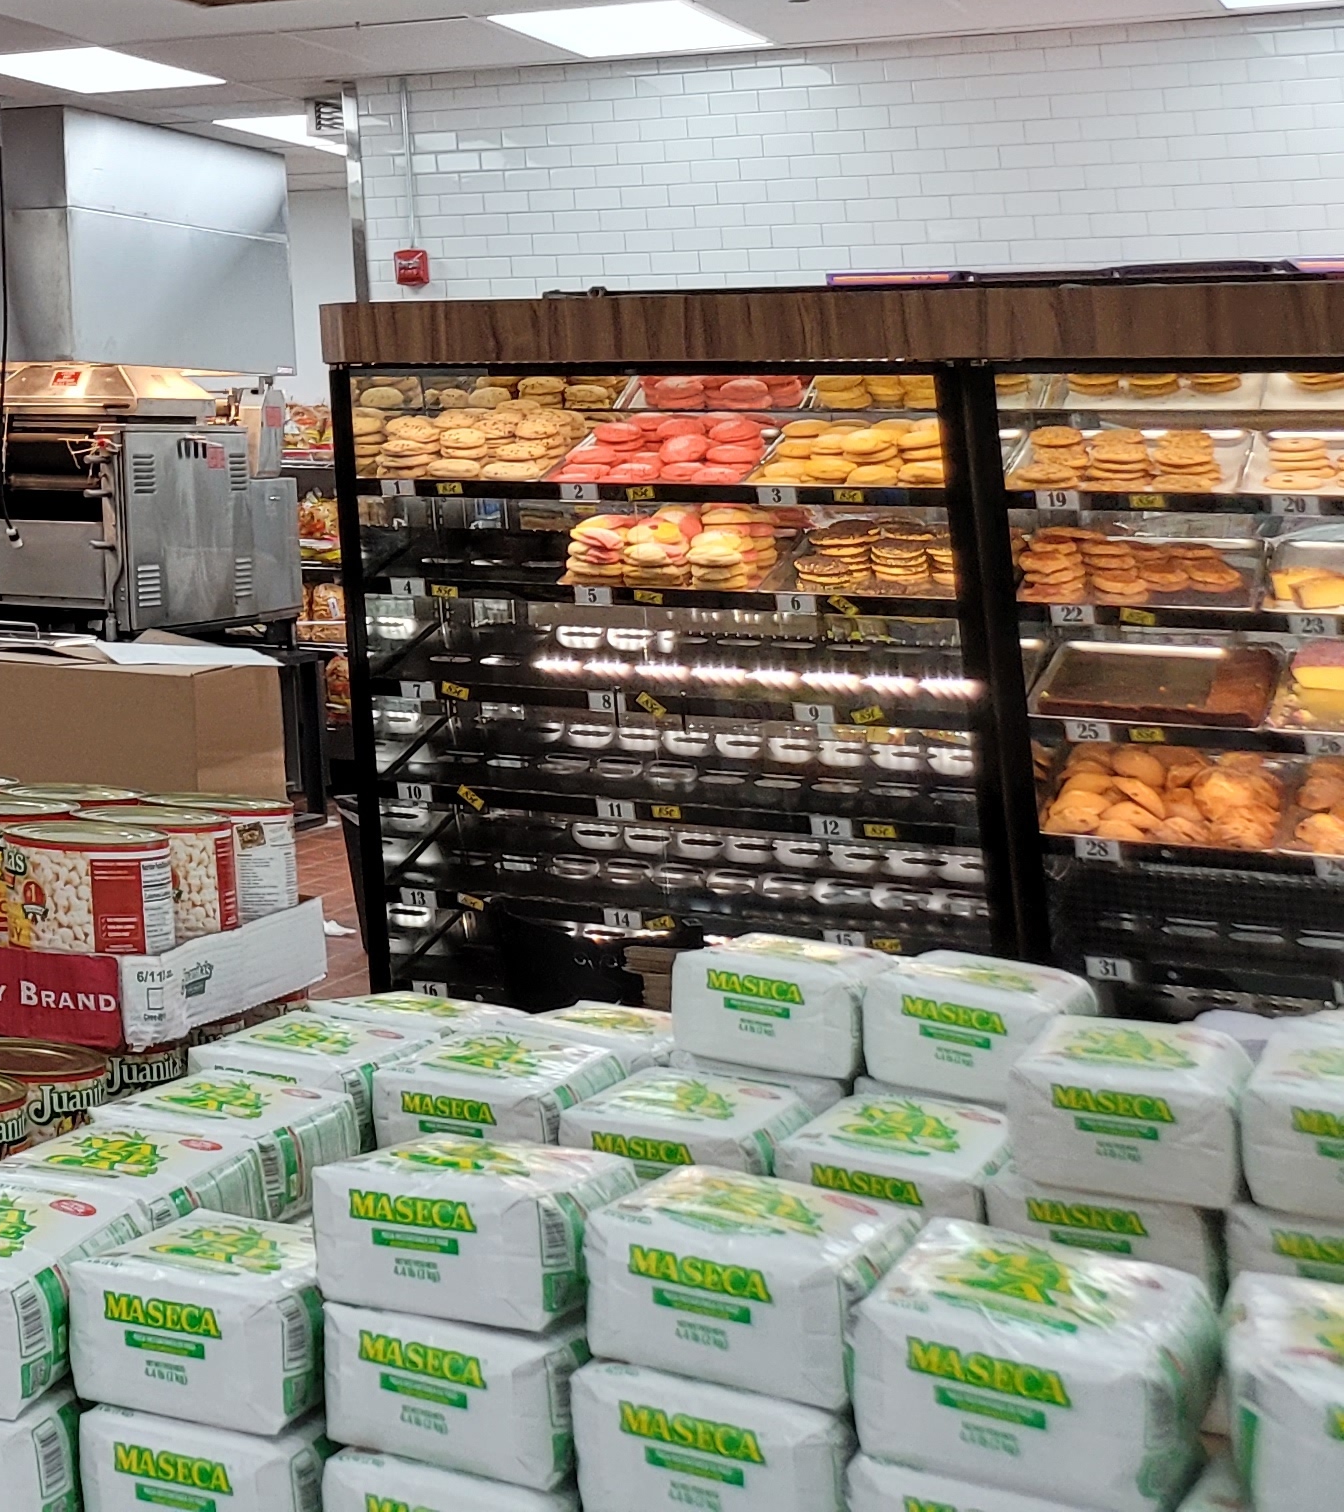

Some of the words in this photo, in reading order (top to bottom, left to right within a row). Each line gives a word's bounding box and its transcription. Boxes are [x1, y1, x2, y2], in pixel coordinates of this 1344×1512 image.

[393, 482, 401, 495] 1
[574, 484, 583, 499] 2
[772, 489, 782, 503] 3
[1047, 492, 1067, 508] 19
[402, 579, 411, 594] 4
[587, 588, 597, 603] 5
[791, 597, 801, 612] 6
[413, 684, 421, 697] 7
[602, 694, 612, 709] 8
[809, 707, 819, 721] 9
[1077, 724, 1098, 739] 25
[408, 786, 422, 799] 10
[609, 804, 622, 817] 11
[822, 820, 839, 835] 12
[1087, 842, 1108, 857] 28
[411, 891, 425, 905] 13
[613, 912, 629, 926] 14
[1100, 962, 1118, 976] 31
[708, 969, 804, 1005] MASECA
[21, 980, 116, 1012] BRAND
[902, 995, 1007, 1036] MASECA
[107, 1056, 184, 1093] Juanita
[402, 1092, 496, 1125] MASECA
[1052, 1085, 1175, 1123] MASECA
[593, 1132, 694, 1165] MASECA
[813, 1163, 922, 1205] MASECA
[350, 1190, 476, 1233] MASECA
[1028, 1198, 1148, 1236] MASECA
[630, 1245, 771, 1304] MASECA
[105, 1292, 222, 1339] MASECA
[360, 1330, 486, 1389] MASECA
[907, 1337, 1071, 1407] MASECA
[619, 1401, 766, 1465] MASECA
[115, 1443, 233, 1496] MASECA
